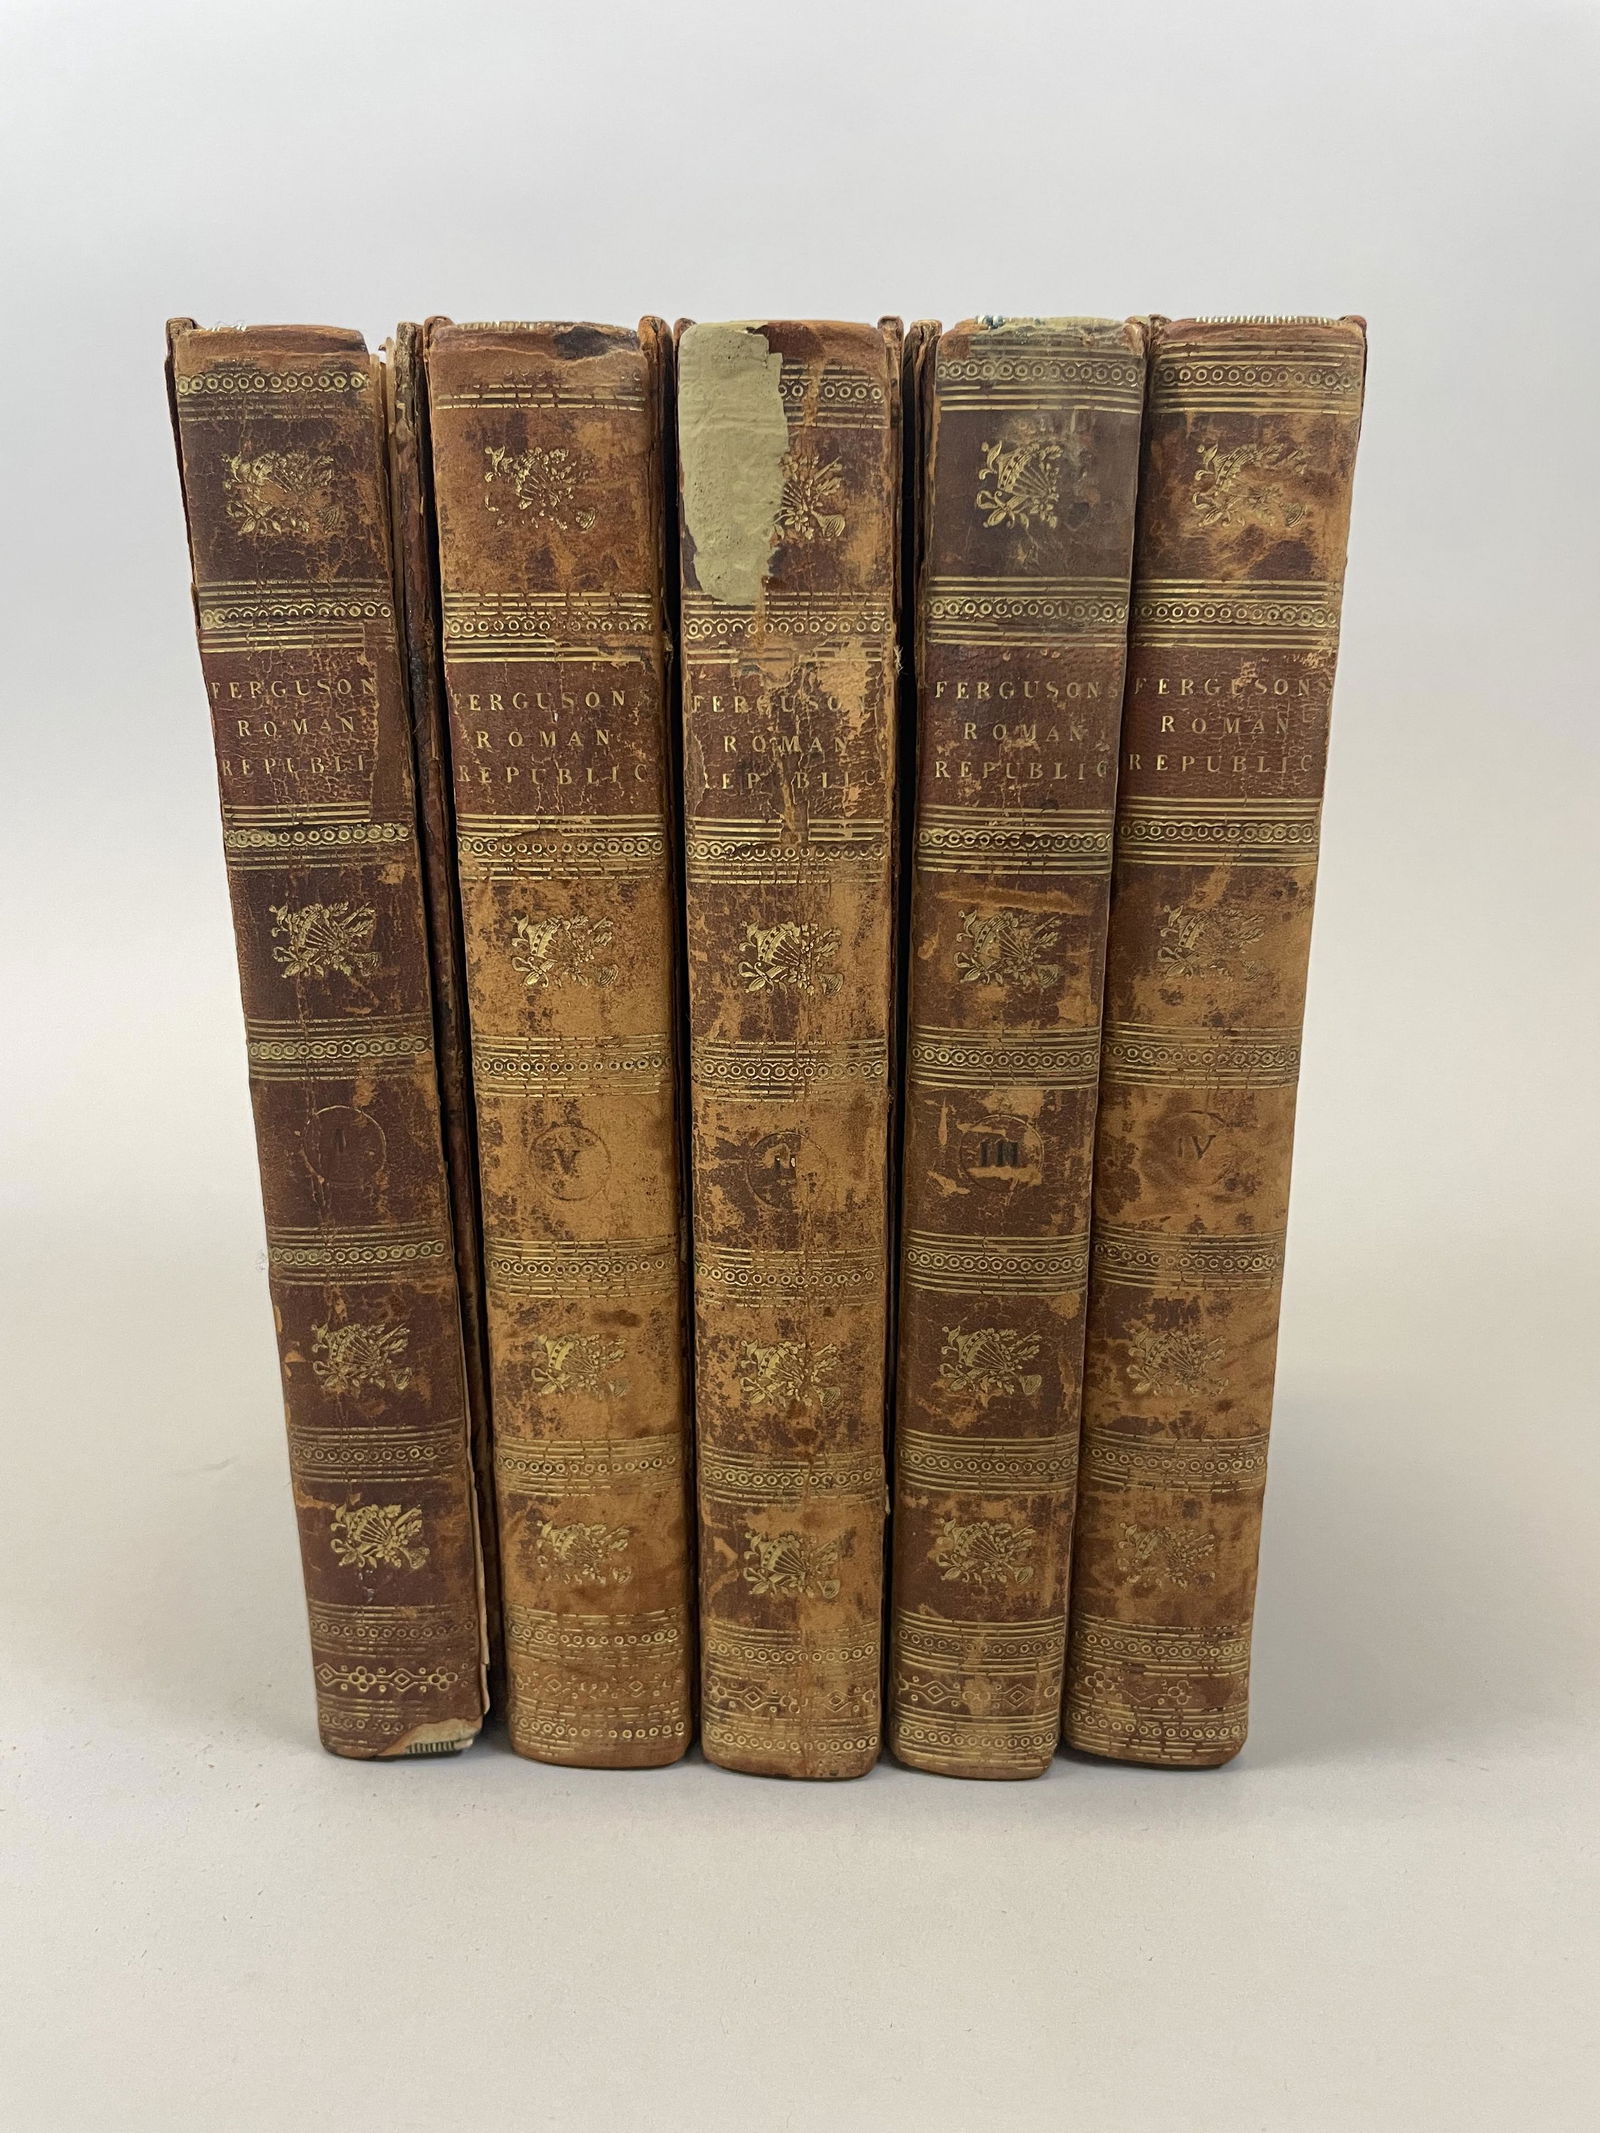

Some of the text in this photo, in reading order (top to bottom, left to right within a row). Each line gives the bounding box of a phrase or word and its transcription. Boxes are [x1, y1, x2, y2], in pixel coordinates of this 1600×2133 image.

[237, 716, 355, 738] ROMAN
[963, 721, 1086, 742] ROMAN
[1160, 714, 1289, 735] ROMAN
[476, 729, 611, 749] ROMAN
[723, 734, 849, 754] ROMAN
[934, 760, 1108, 781] REPUBLIC
[1128, 753, 1313, 774] REPUBLIC
[457, 763, 649, 786] REPUBLIC
[1176, 1133, 1217, 1161] IV
